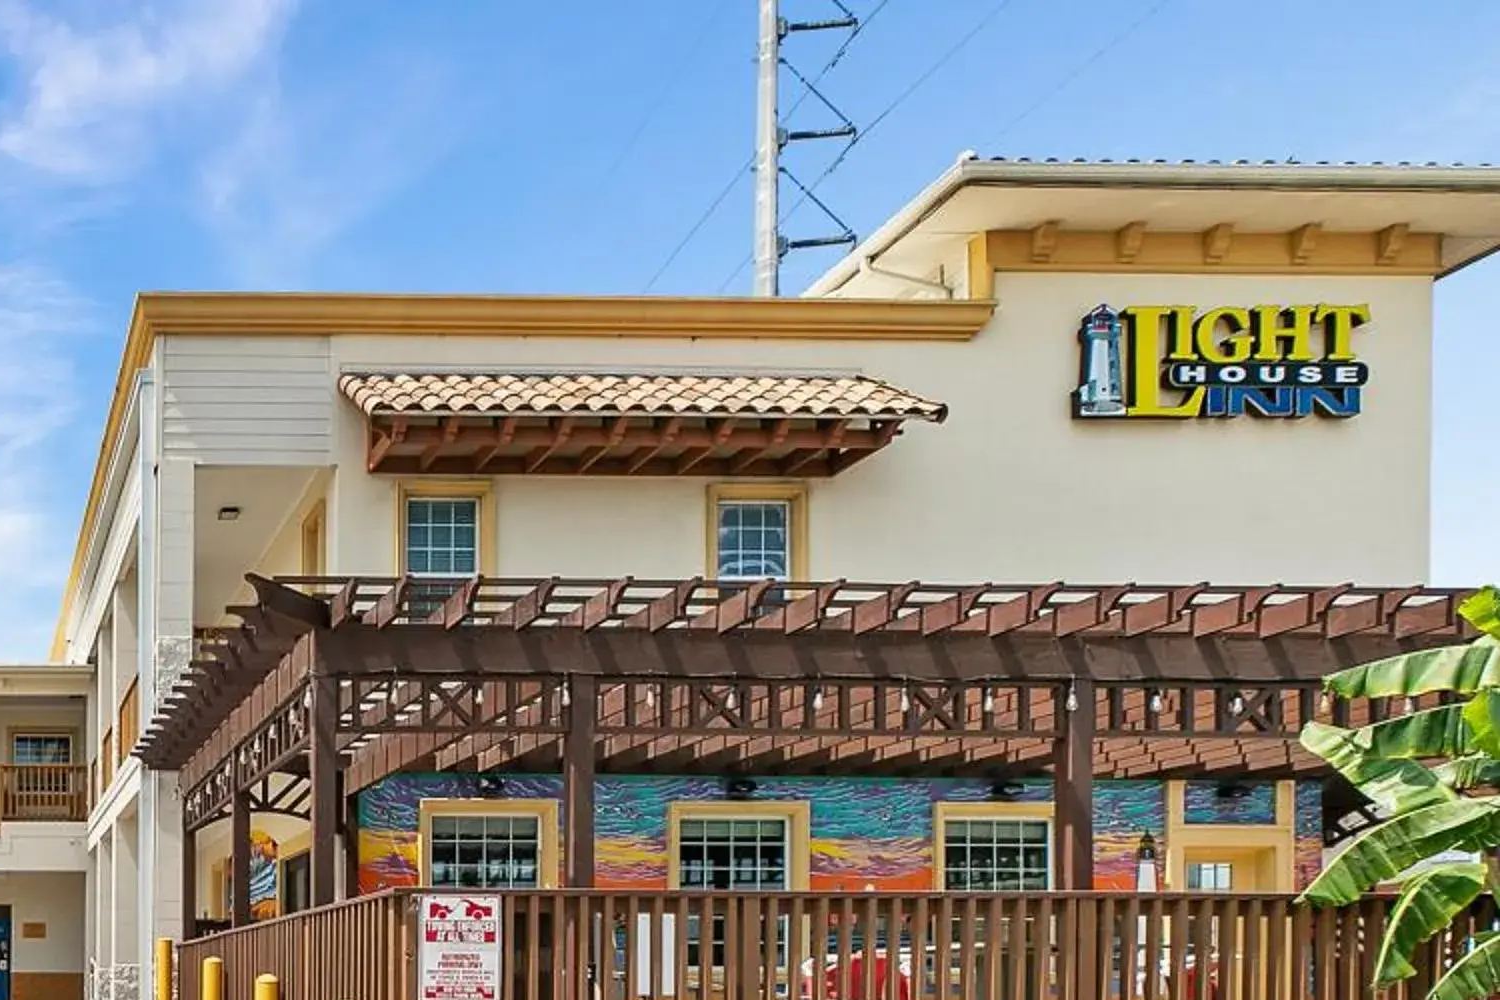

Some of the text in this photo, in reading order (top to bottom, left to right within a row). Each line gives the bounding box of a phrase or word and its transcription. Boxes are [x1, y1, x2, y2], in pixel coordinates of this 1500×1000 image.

[1125, 304, 1370, 416] LIGHT
[1180, 365, 1359, 383] HOUSE
[1204, 385, 1361, 417] INN
